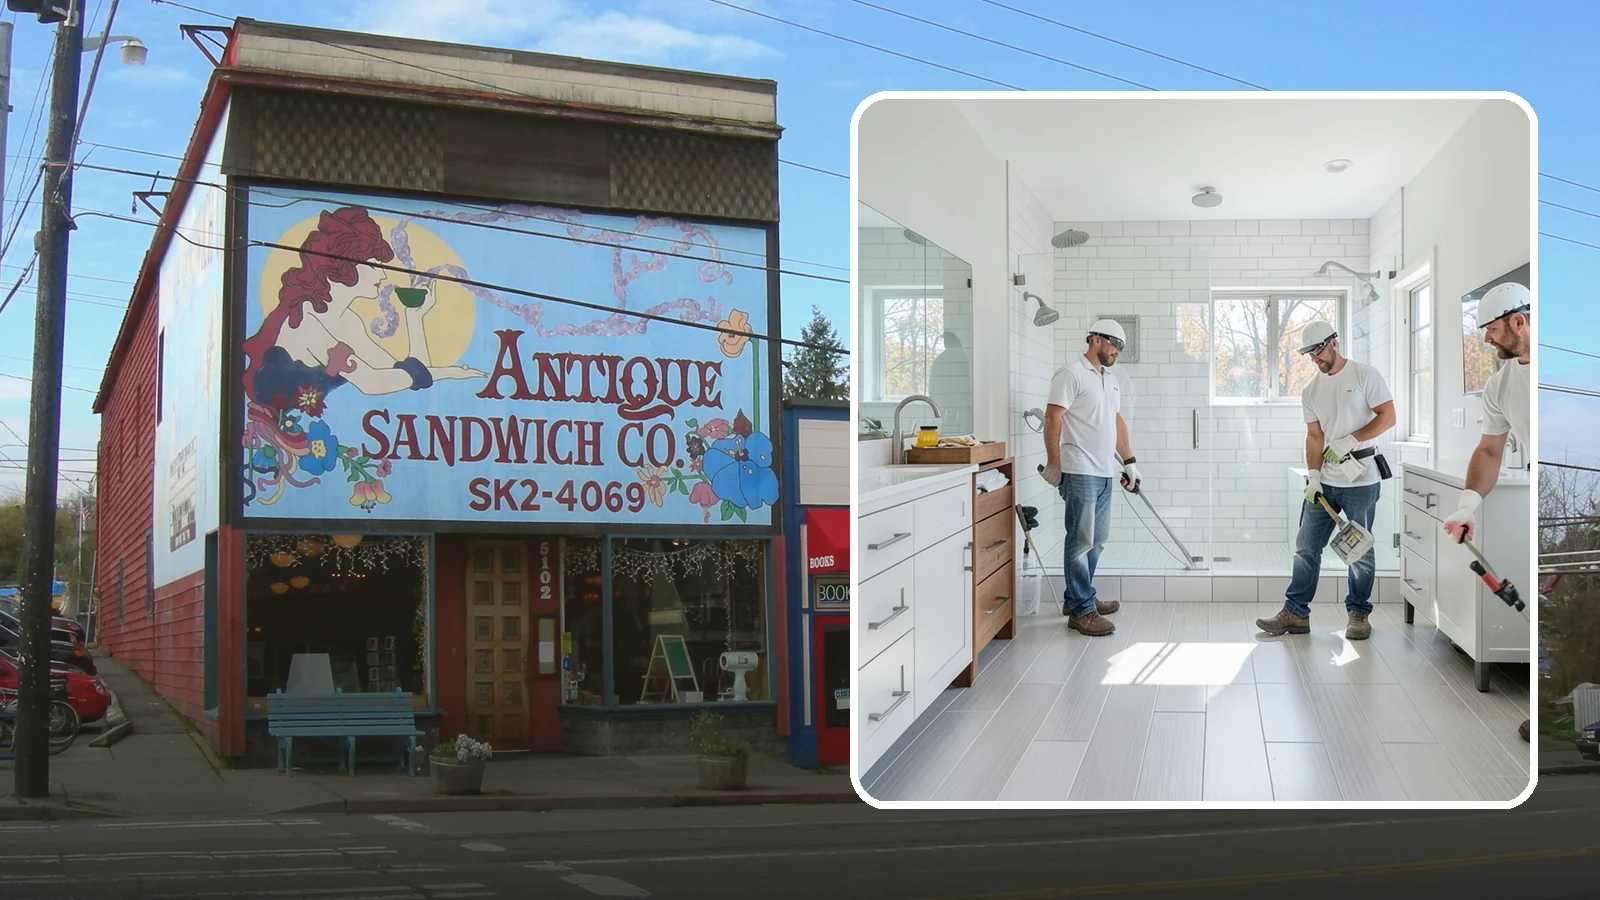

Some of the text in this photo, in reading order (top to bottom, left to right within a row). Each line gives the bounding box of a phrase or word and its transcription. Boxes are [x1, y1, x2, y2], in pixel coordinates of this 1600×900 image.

[476, 329, 723, 420] ANTIQUE
[361, 409, 684, 469] SANDWICH CO.
[468, 478, 646, 513] SK2-4069
[539, 542, 552, 599] 5102
[809, 555, 835, 569] BOOKS
